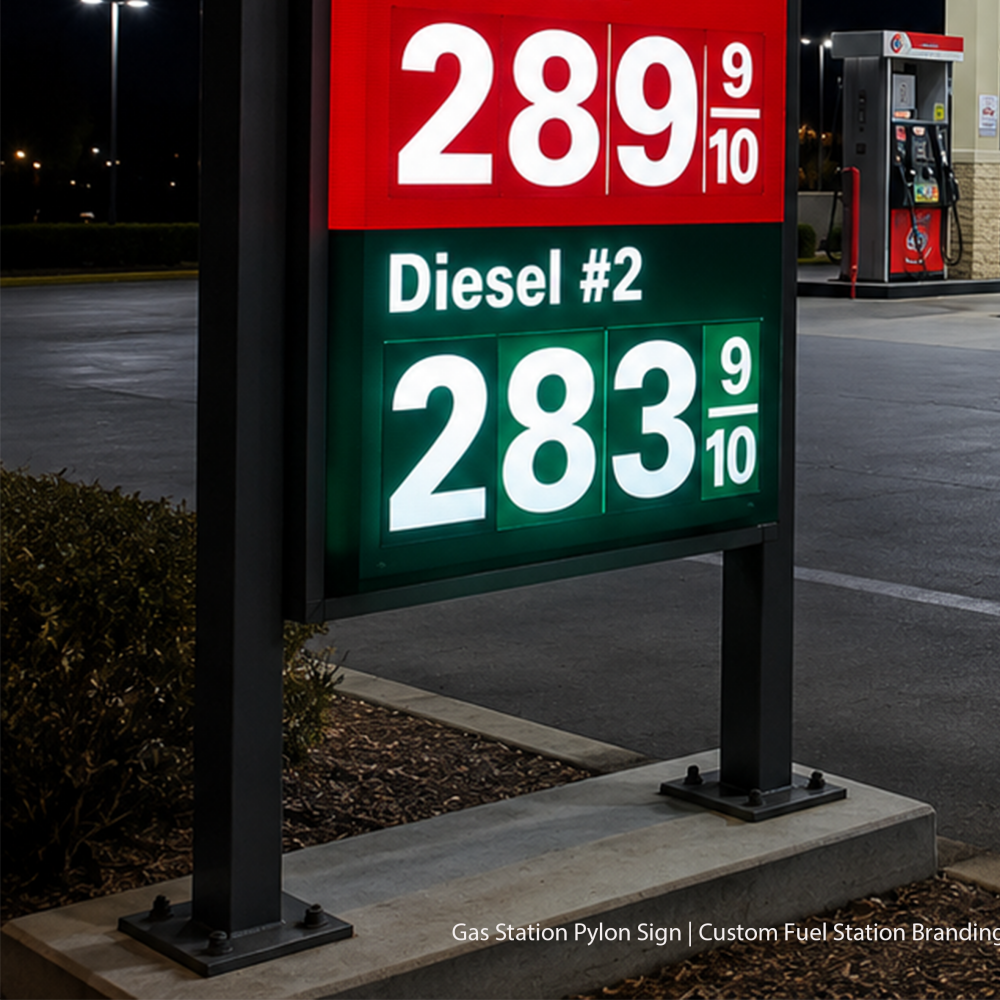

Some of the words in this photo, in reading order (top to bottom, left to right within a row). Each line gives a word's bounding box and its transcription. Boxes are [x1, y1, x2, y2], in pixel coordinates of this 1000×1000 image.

[721, 42, 753, 98] 9
[398, 23, 698, 186] 289
[708, 128, 759, 184] 10
[388, 249, 561, 313] Diesel
[580, 247, 642, 302] #2
[720, 337, 752, 395] 9
[390, 340, 696, 531] 283
[705, 426, 757, 487] 10
